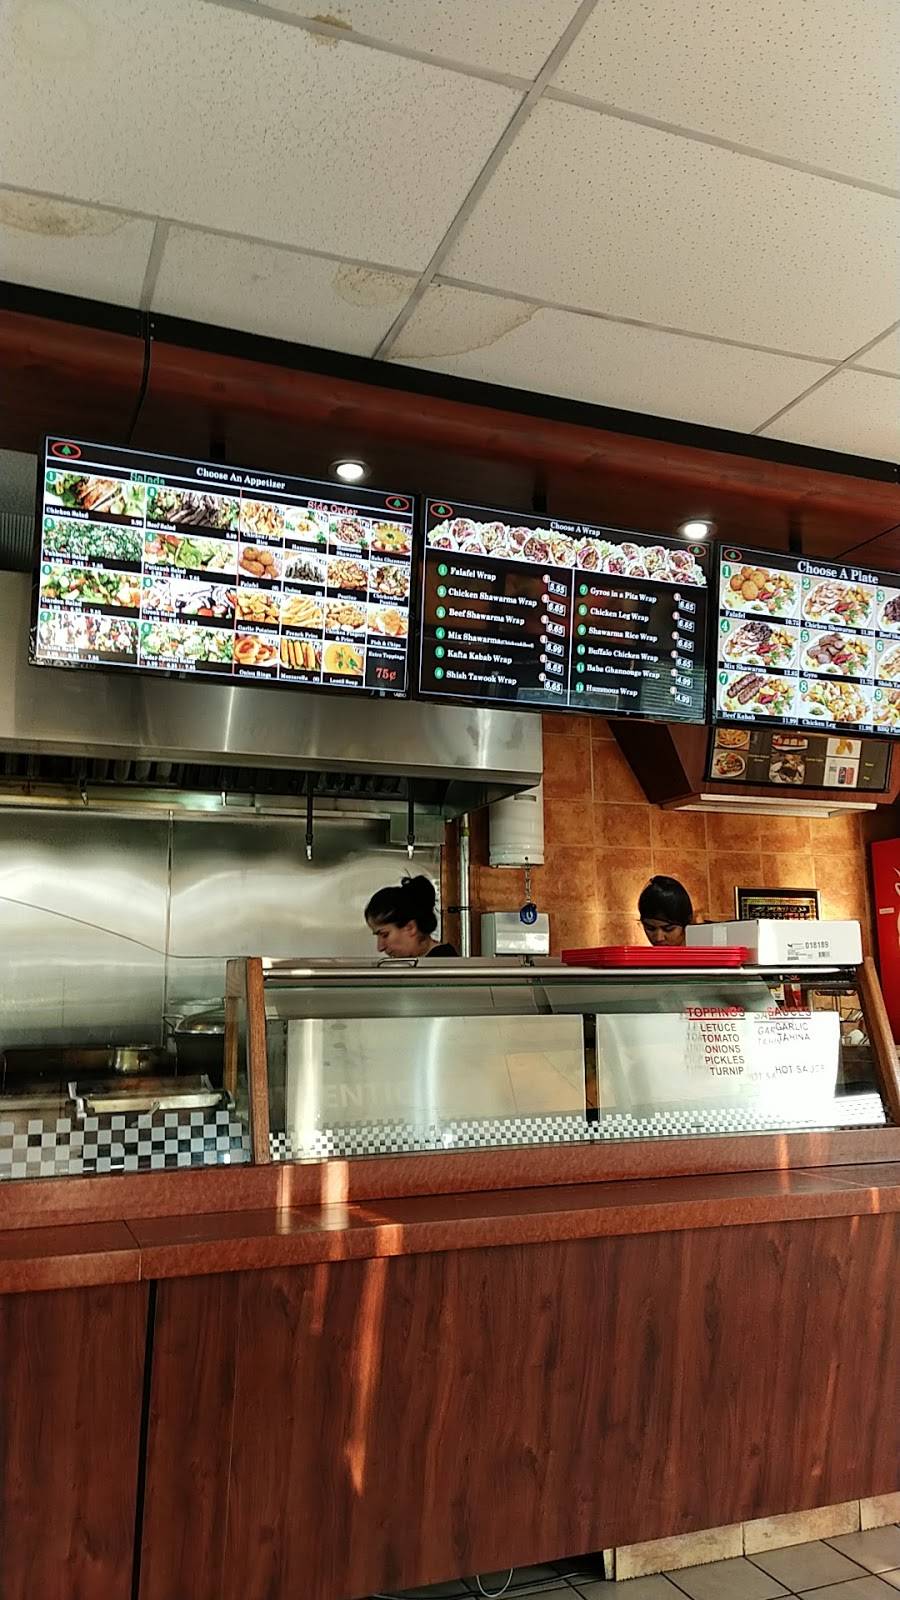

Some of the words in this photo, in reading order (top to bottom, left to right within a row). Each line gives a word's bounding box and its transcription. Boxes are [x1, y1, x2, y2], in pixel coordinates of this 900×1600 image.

[196, 467, 228, 481] Choose
[230, 472, 242, 483] An
[244, 475, 286, 490] Appetizer
[46, 507, 71, 517] Chicken
[72, 510, 89, 519] Salad
[307, 500, 328, 511] Side
[330, 504, 358, 516] Order
[160, 523, 176, 532] Salad
[550, 521, 574, 532] Choose
[582, 527, 600, 537] Wrap
[451, 567, 475, 578] Falafel
[477, 570, 496, 582] Wrap
[797, 561, 838, 578] Choose
[839, 567, 848, 579] A
[850, 569, 878, 584] Plate
[550, 583, 565, 594] 5.55
[448, 588, 478, 599] Chicken
[480, 593, 517, 604] Shawarma
[518, 597, 537, 608] Wrap
[590, 587, 610, 597] Gyros
[611, 590, 618, 598] in
[625, 591, 638, 599] Pita
[639, 594, 657, 603] Wrap
[449, 608, 465, 617] Beef
[466, 611, 504, 623] Shawarma
[505, 615, 524, 626] Wrap
[590, 608, 617, 618] Chicken
[619, 611, 630, 620] Leg
[631, 613, 649, 622] Wrap
[725, 610, 746, 619] Falafel
[805, 621, 826, 631] Chicken
[828, 624, 856, 634] Shawarma
[448, 631, 462, 640] Mix
[589, 627, 623, 638] Shawarma
[625, 631, 639, 640] Rice
[640, 633, 658, 643] Wrap
[448, 650, 467, 659] Kafta
[469, 651, 492, 662] Kabab
[493, 655, 512, 665] Wrap
[588, 647, 612, 657] Buffalo
[613, 649, 640, 660] Chicken
[640, 653, 658, 662] Wrap
[587, 664, 603, 673] Baba
[642, 669, 660, 679] Wrap
[724, 662, 736, 670] Mix
[738, 664, 766, 673] Shawarma
[375, 667, 397, 681] 75¢
[446, 671, 467, 680] Shish
[468, 672, 497, 683] Tawook
[498, 676, 517, 686] Wrap
[586, 684, 619, 694] Hummous
[620, 687, 638, 697] Wrap
[722, 712, 735, 720] Beef
[736, 713, 755, 721] Kabab
[802, 719, 825, 727] Chicken
[826, 721, 836, 729] Leg
[687, 1007, 746, 1018] TOPPINGS
[767, 1007, 811, 1017] SAUCES
[700, 1023, 736, 1033] LETUCE
[775, 1022, 809, 1031] GARLIC
[702, 1033, 739, 1043] TOMATO
[704, 1044, 741, 1054] ONIONS
[704, 1055, 745, 1065] PICKLES
[710, 1066, 744, 1076] TURNIP
[775, 1065, 793, 1074] HOT
